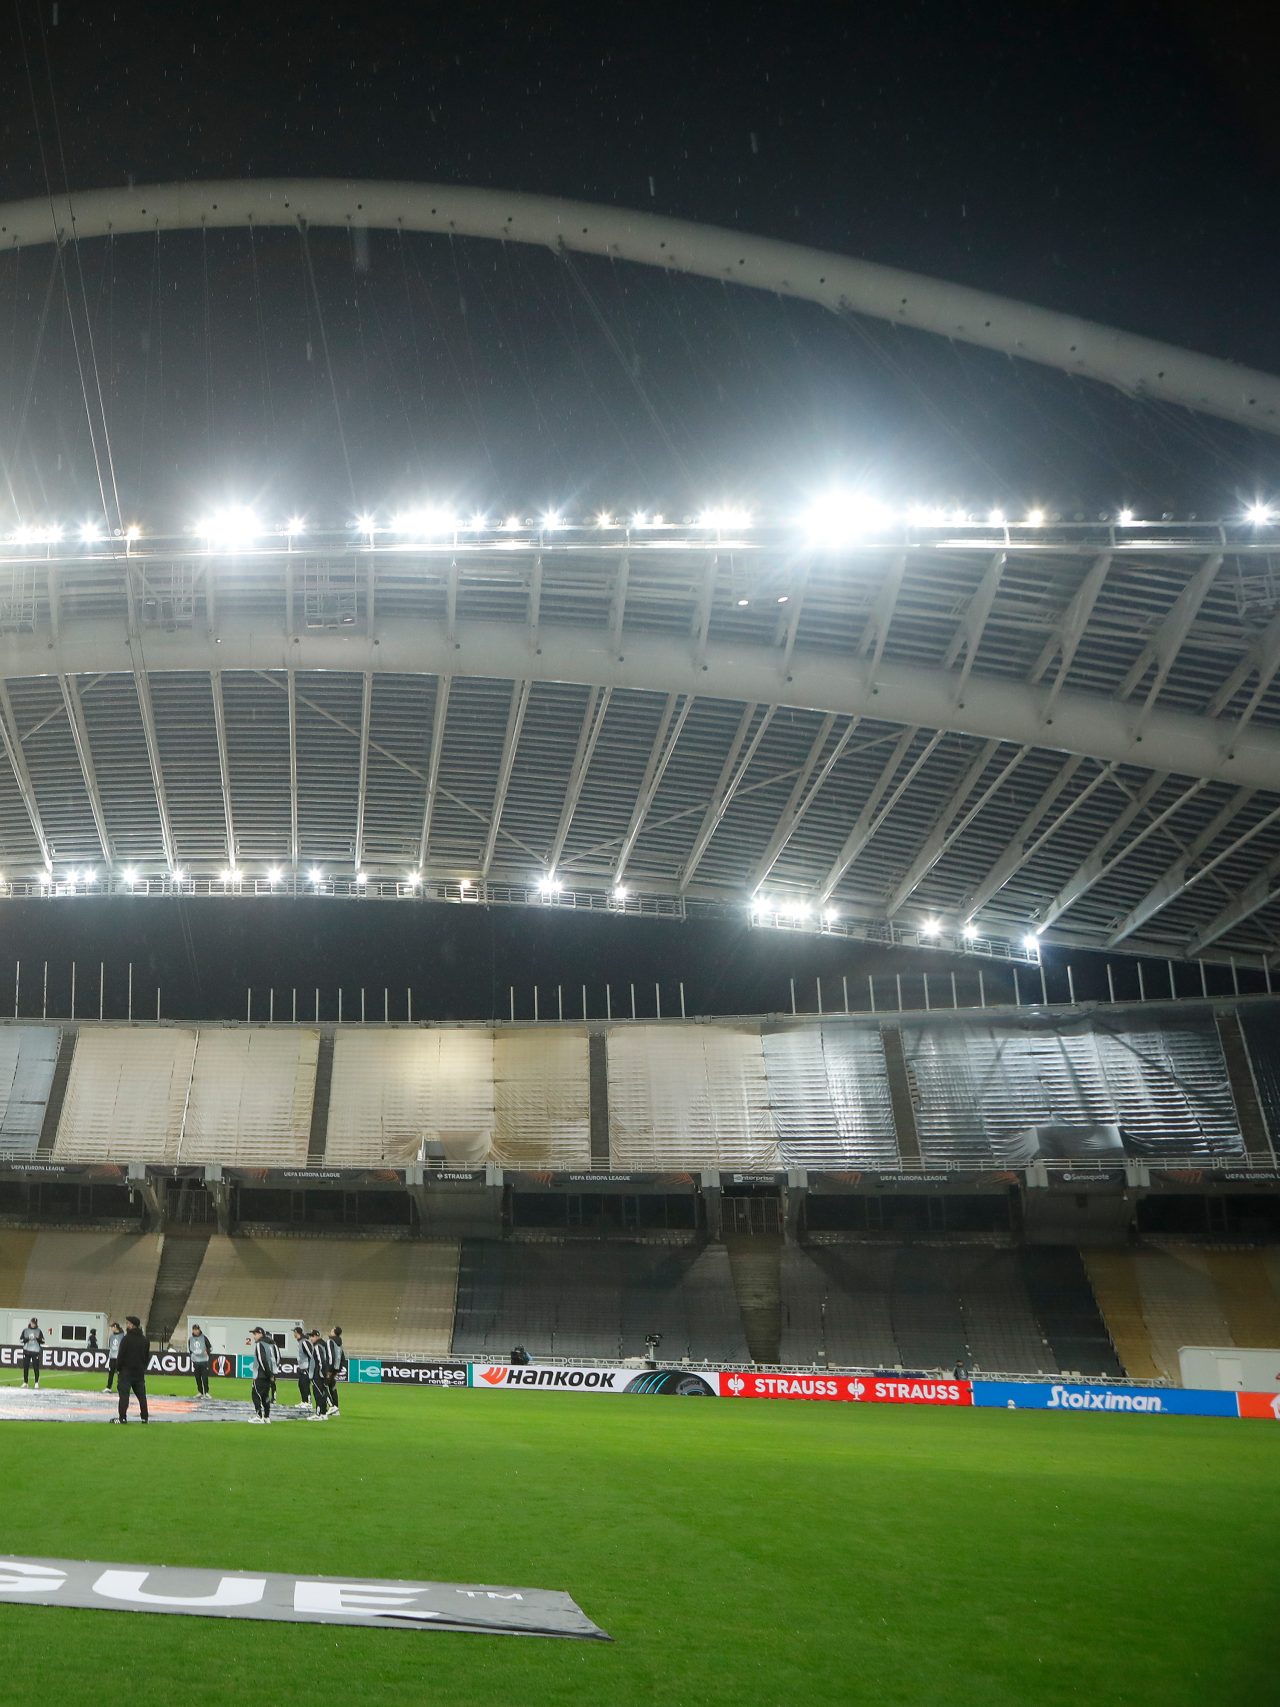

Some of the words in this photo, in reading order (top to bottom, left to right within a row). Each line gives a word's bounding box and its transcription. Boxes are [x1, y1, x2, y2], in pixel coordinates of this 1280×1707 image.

[245, 1337, 252, 1345] 2
[365, 1366, 465, 1381] enterprise
[754, 1378, 838, 1395] STRAUSS
[875, 1383, 960, 1400] STRAUSS
[1047, 1385, 1162, 1411] Stoiximan
